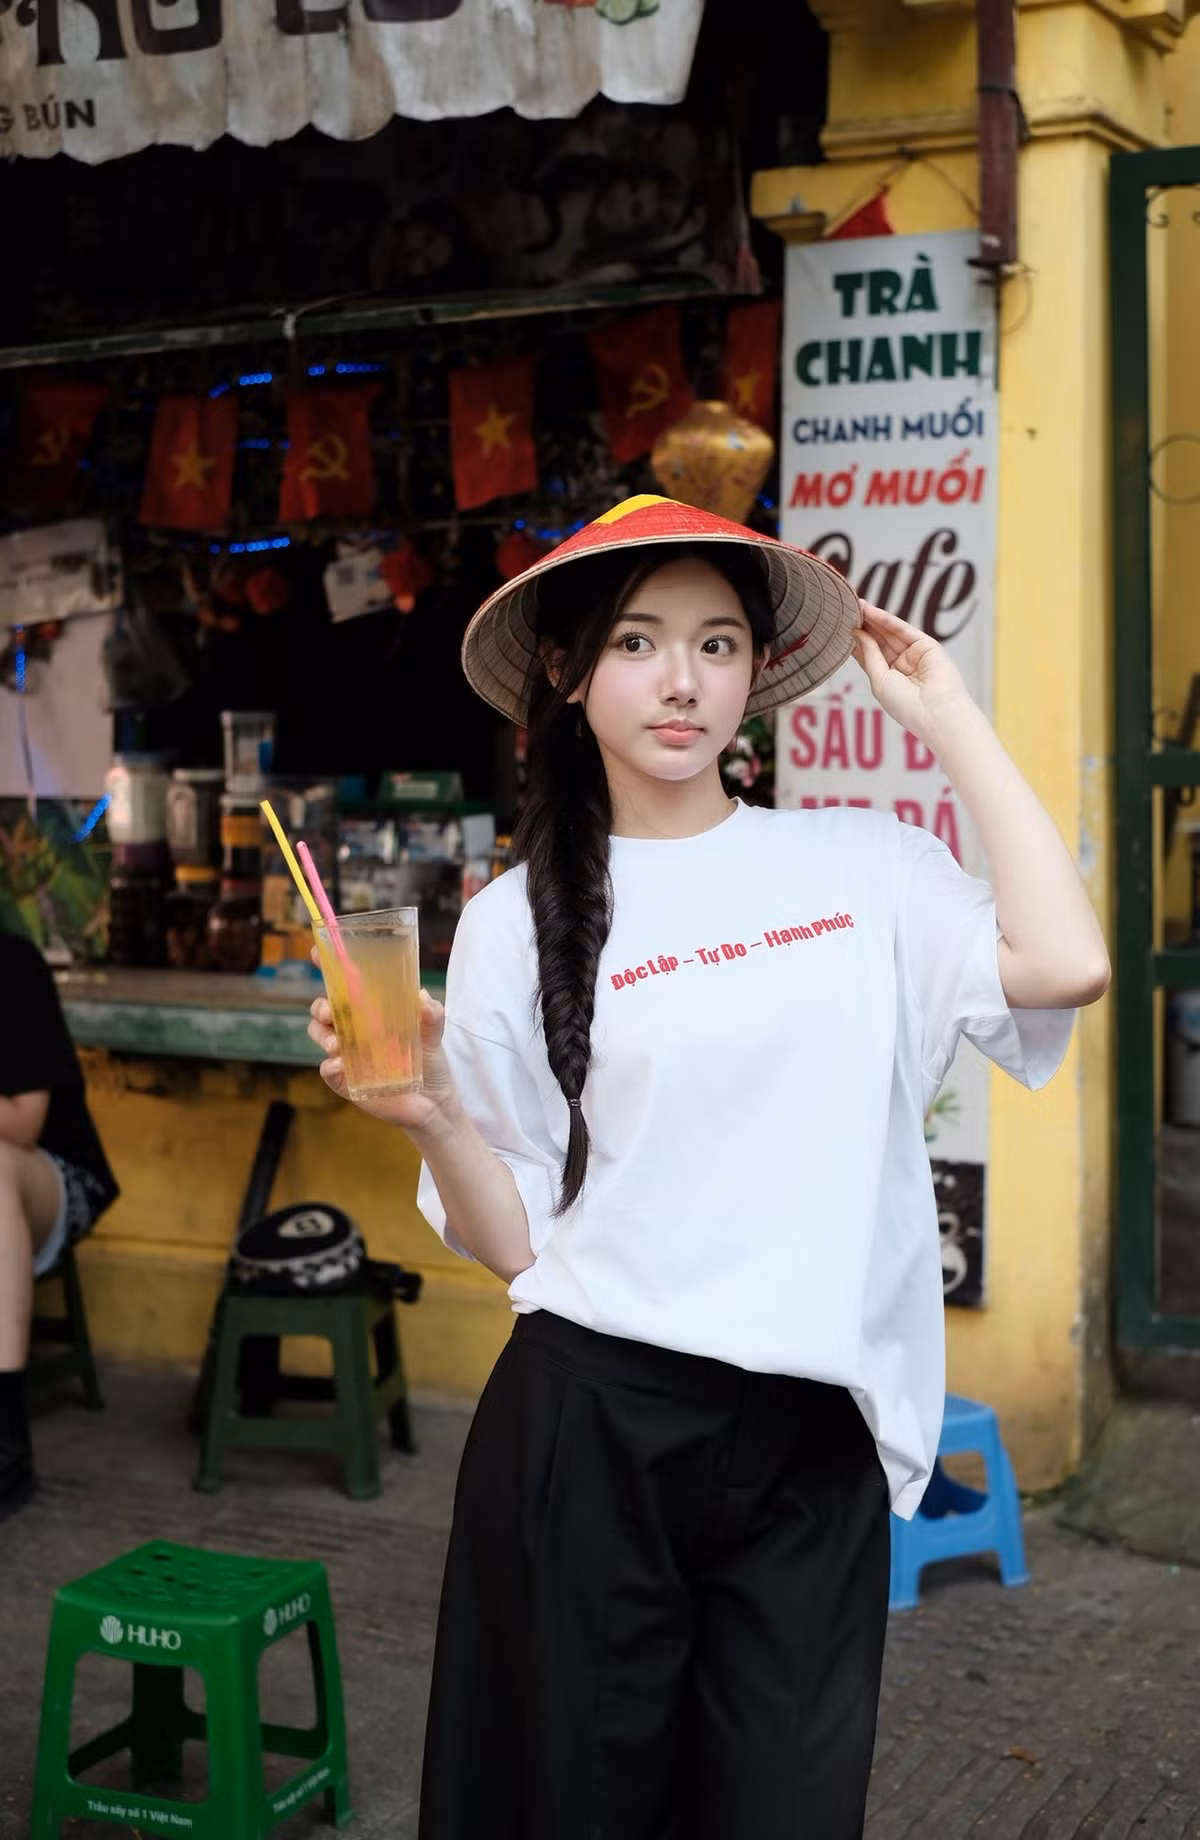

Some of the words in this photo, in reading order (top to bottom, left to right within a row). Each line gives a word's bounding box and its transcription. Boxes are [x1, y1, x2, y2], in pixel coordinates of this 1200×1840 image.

[23, 93, 96, 131] BÚN
[833, 253, 939, 318] TRÀ
[795, 330, 982, 387] CHANH
[793, 414, 892, 444] CHANH
[901, 397, 984, 440] MUỐI
[863, 449, 987, 507] MUỐI
[789, 683, 884, 771] SẤU
[611, 968, 649, 990] Độc
[646, 955, 679, 975] Lập
[694, 947, 721, 966] Tự
[720, 943, 747, 960] Do
[763, 925, 815, 948] Hạnh
[810, 912, 854, 936] Phúc
[128, 1623, 182, 1650] HUHO
[279, 1592, 311, 1624] HUHO
